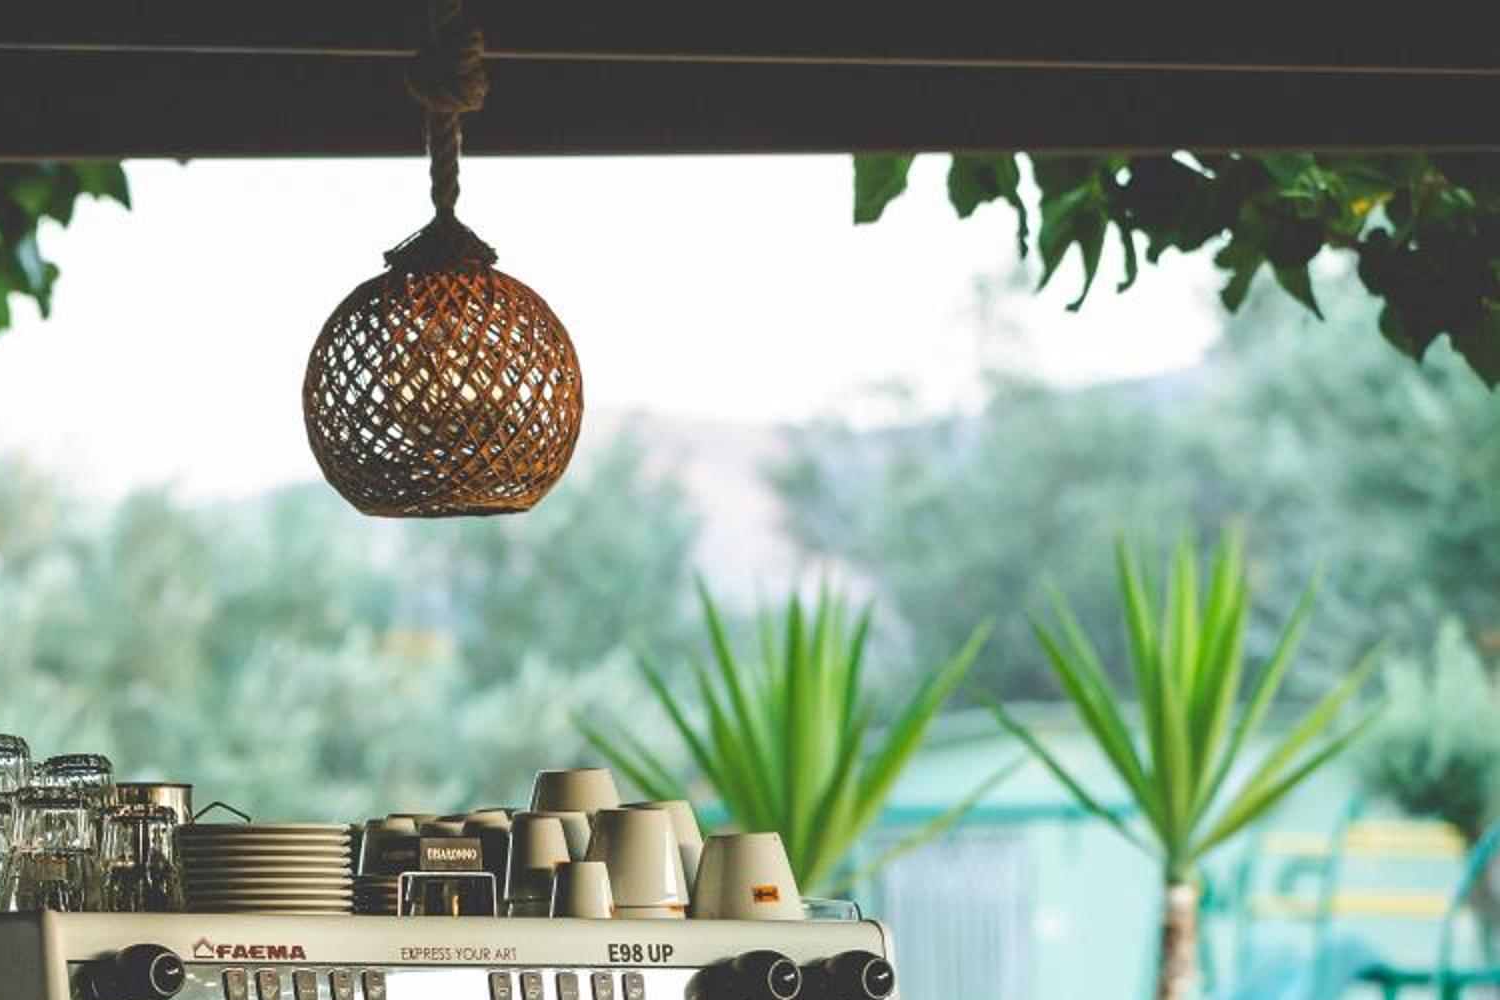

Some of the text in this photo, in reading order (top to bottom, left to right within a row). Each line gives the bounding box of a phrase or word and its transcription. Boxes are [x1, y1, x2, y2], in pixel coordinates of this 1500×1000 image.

[215, 944, 307, 960] FAEMA
[401, 947, 517, 961] EXPRESS YOUR ART
[607, 943, 674, 964] E98 UP
